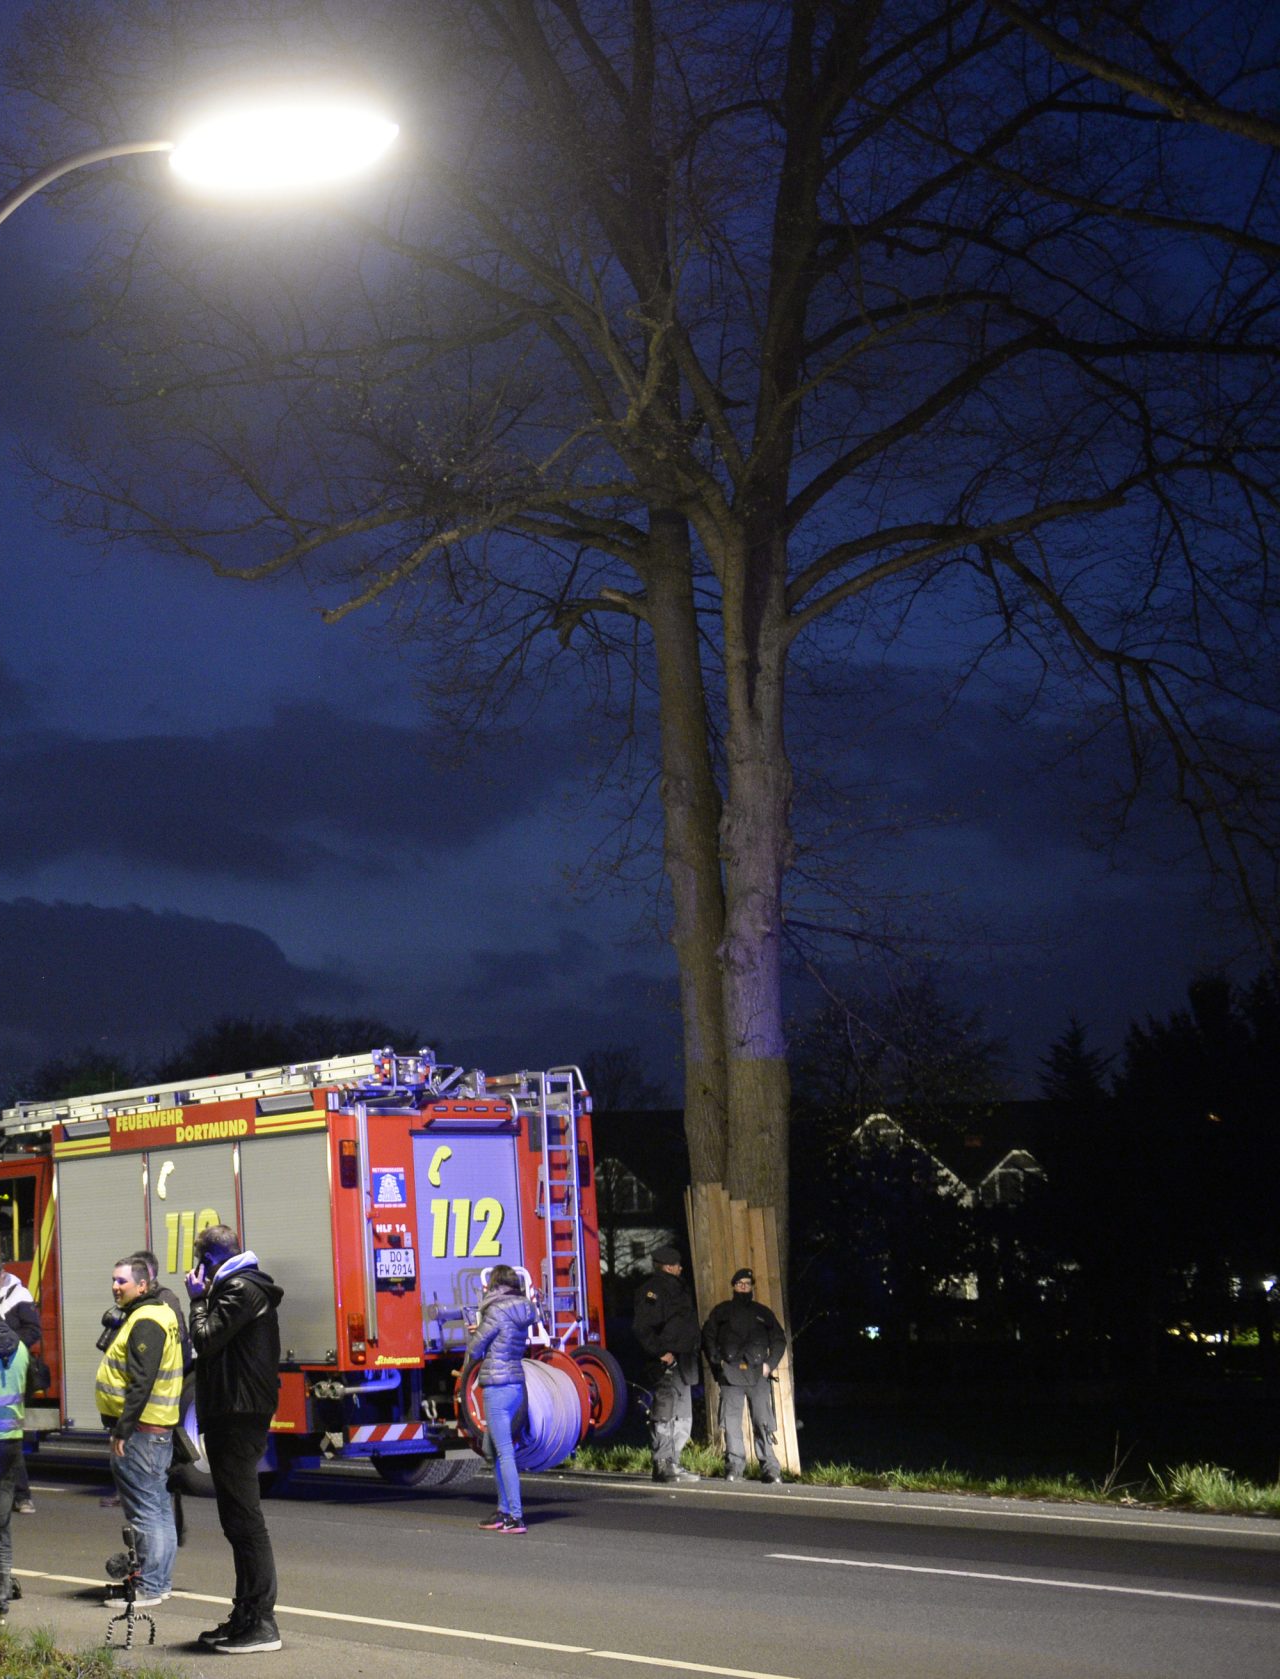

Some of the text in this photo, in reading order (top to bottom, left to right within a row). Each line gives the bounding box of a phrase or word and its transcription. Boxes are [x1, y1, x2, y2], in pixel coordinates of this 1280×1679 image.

[116, 1108, 184, 1132] FEUERWEHR
[175, 1119, 248, 1142] DORTMUND
[376, 1223, 407, 1233] HLF 14
[430, 1197, 504, 1258] 112
[390, 1251, 402, 1263] DO
